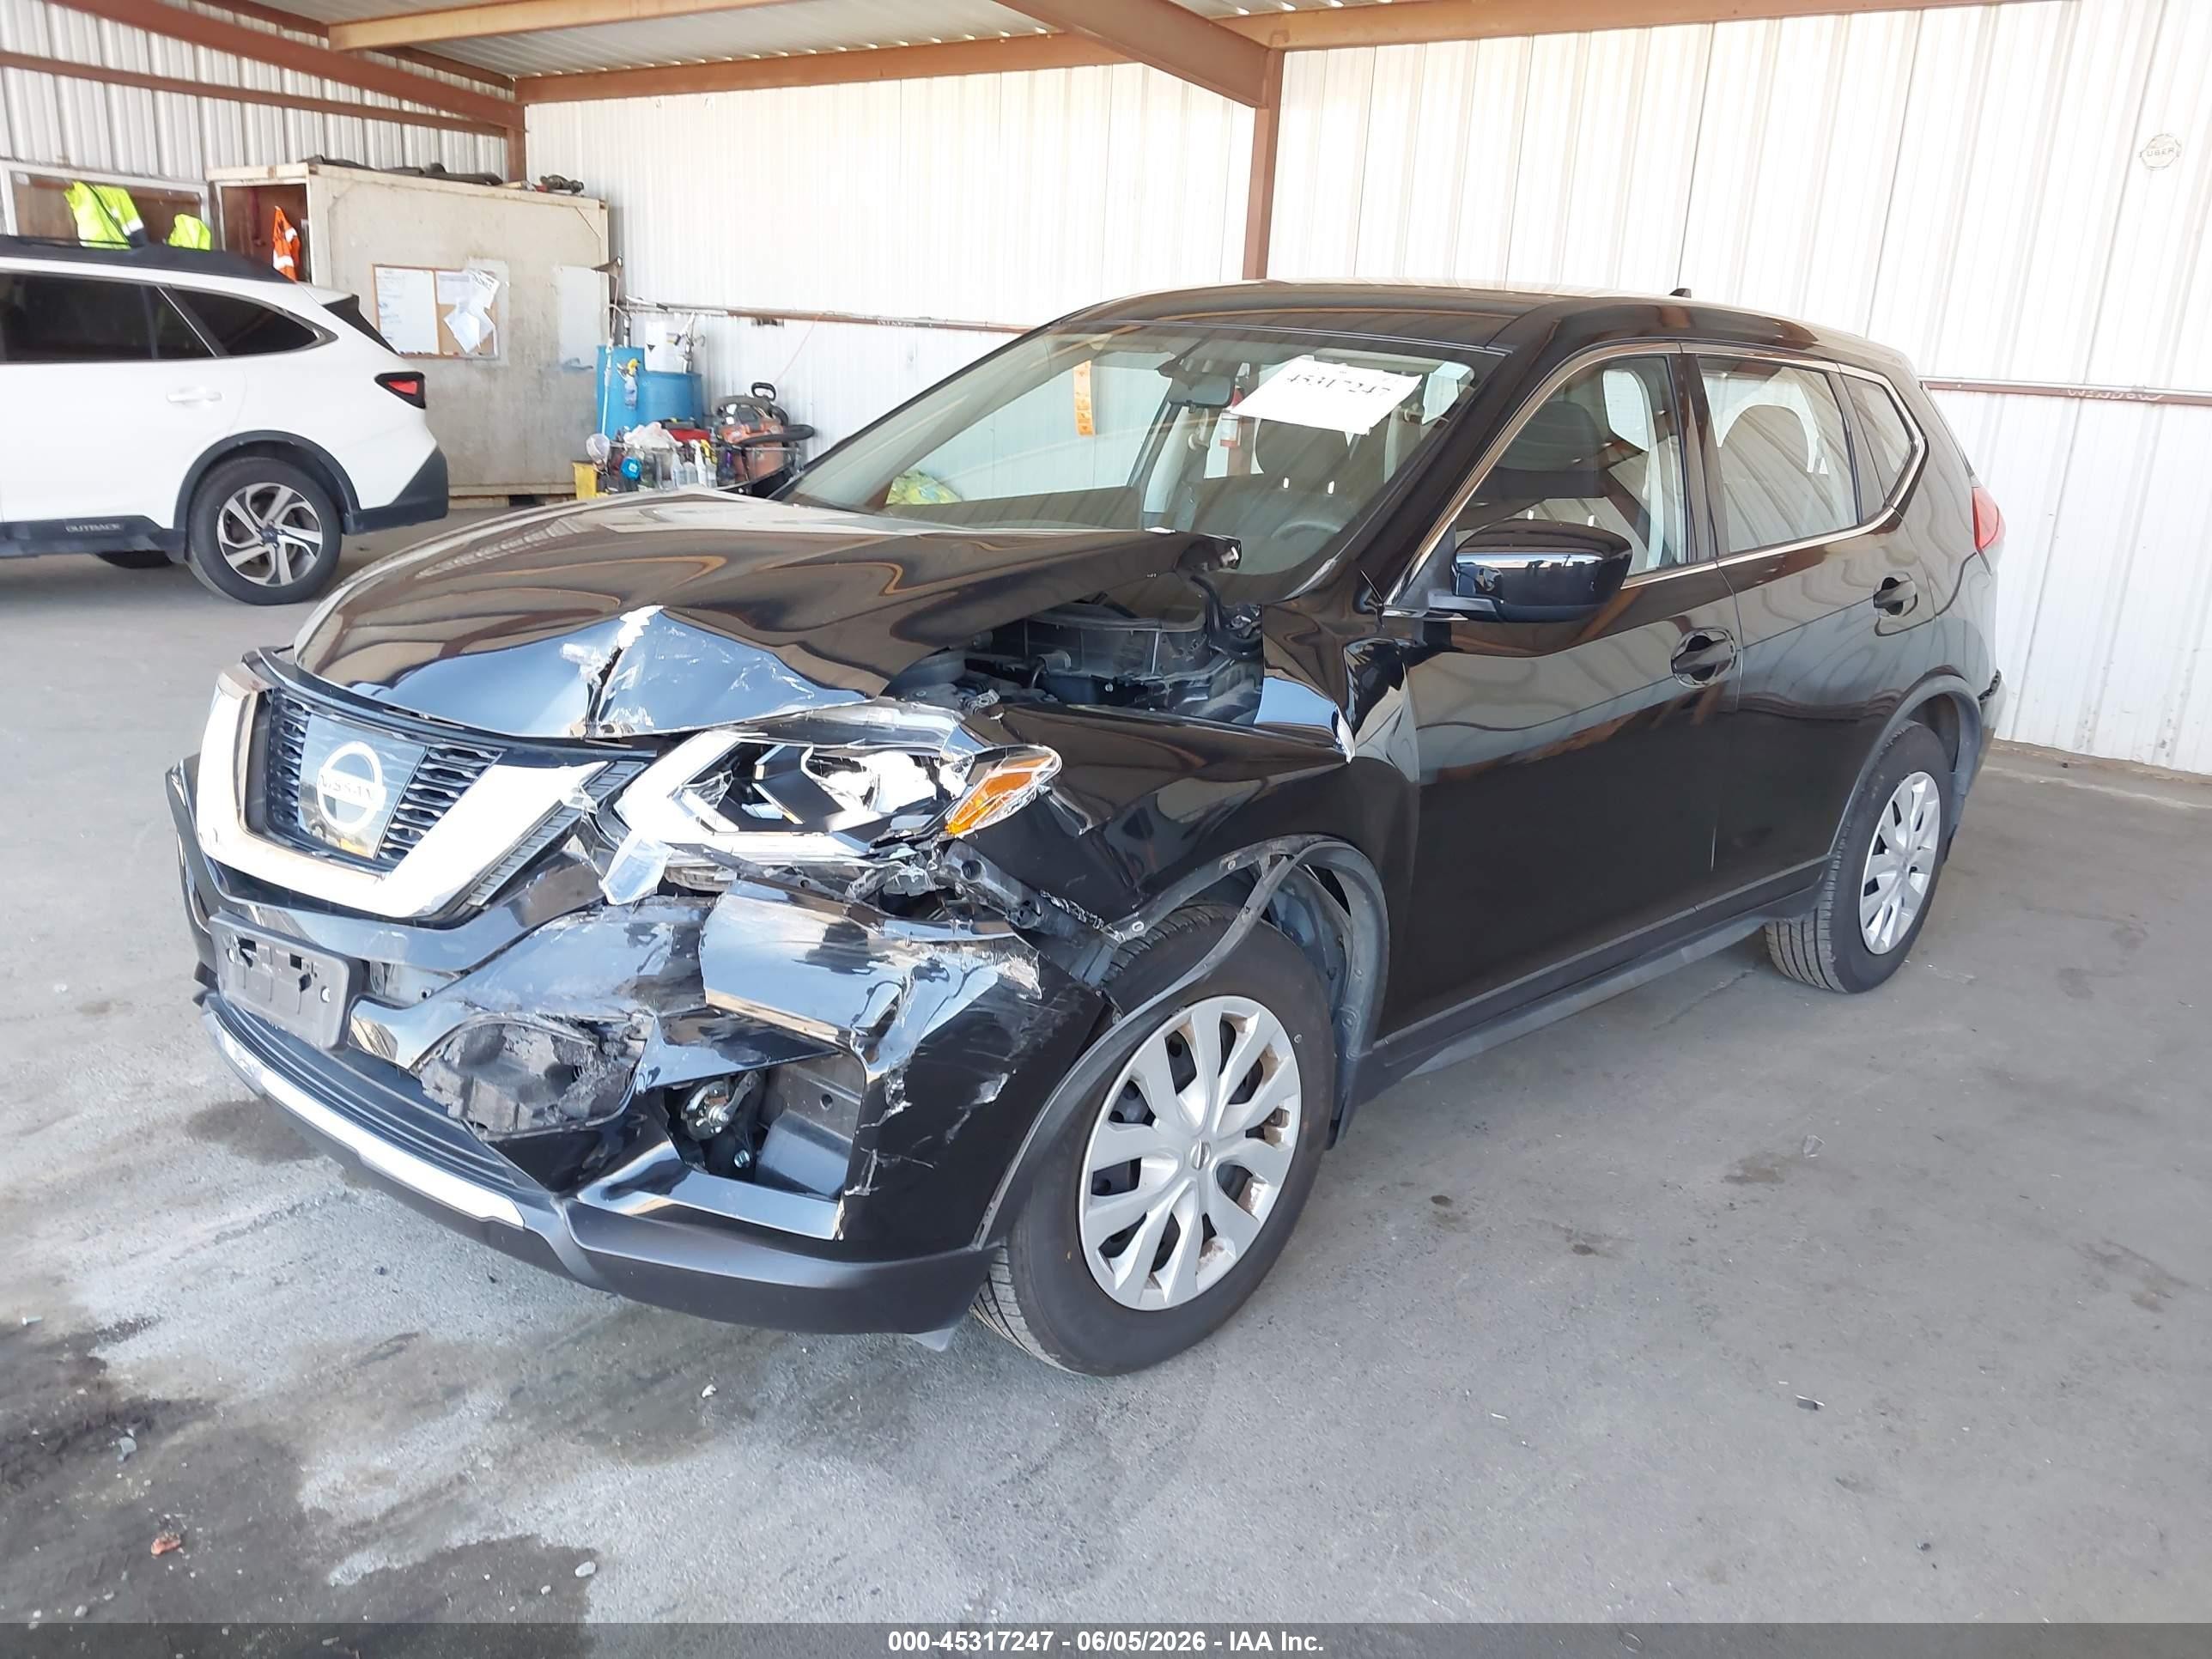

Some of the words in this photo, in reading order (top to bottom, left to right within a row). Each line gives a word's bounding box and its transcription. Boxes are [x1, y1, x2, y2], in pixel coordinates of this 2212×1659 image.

[2146, 147, 2175, 157] UBER
[65, 522, 122, 533] OUTBACK
[319, 774, 374, 800] NISSAN
